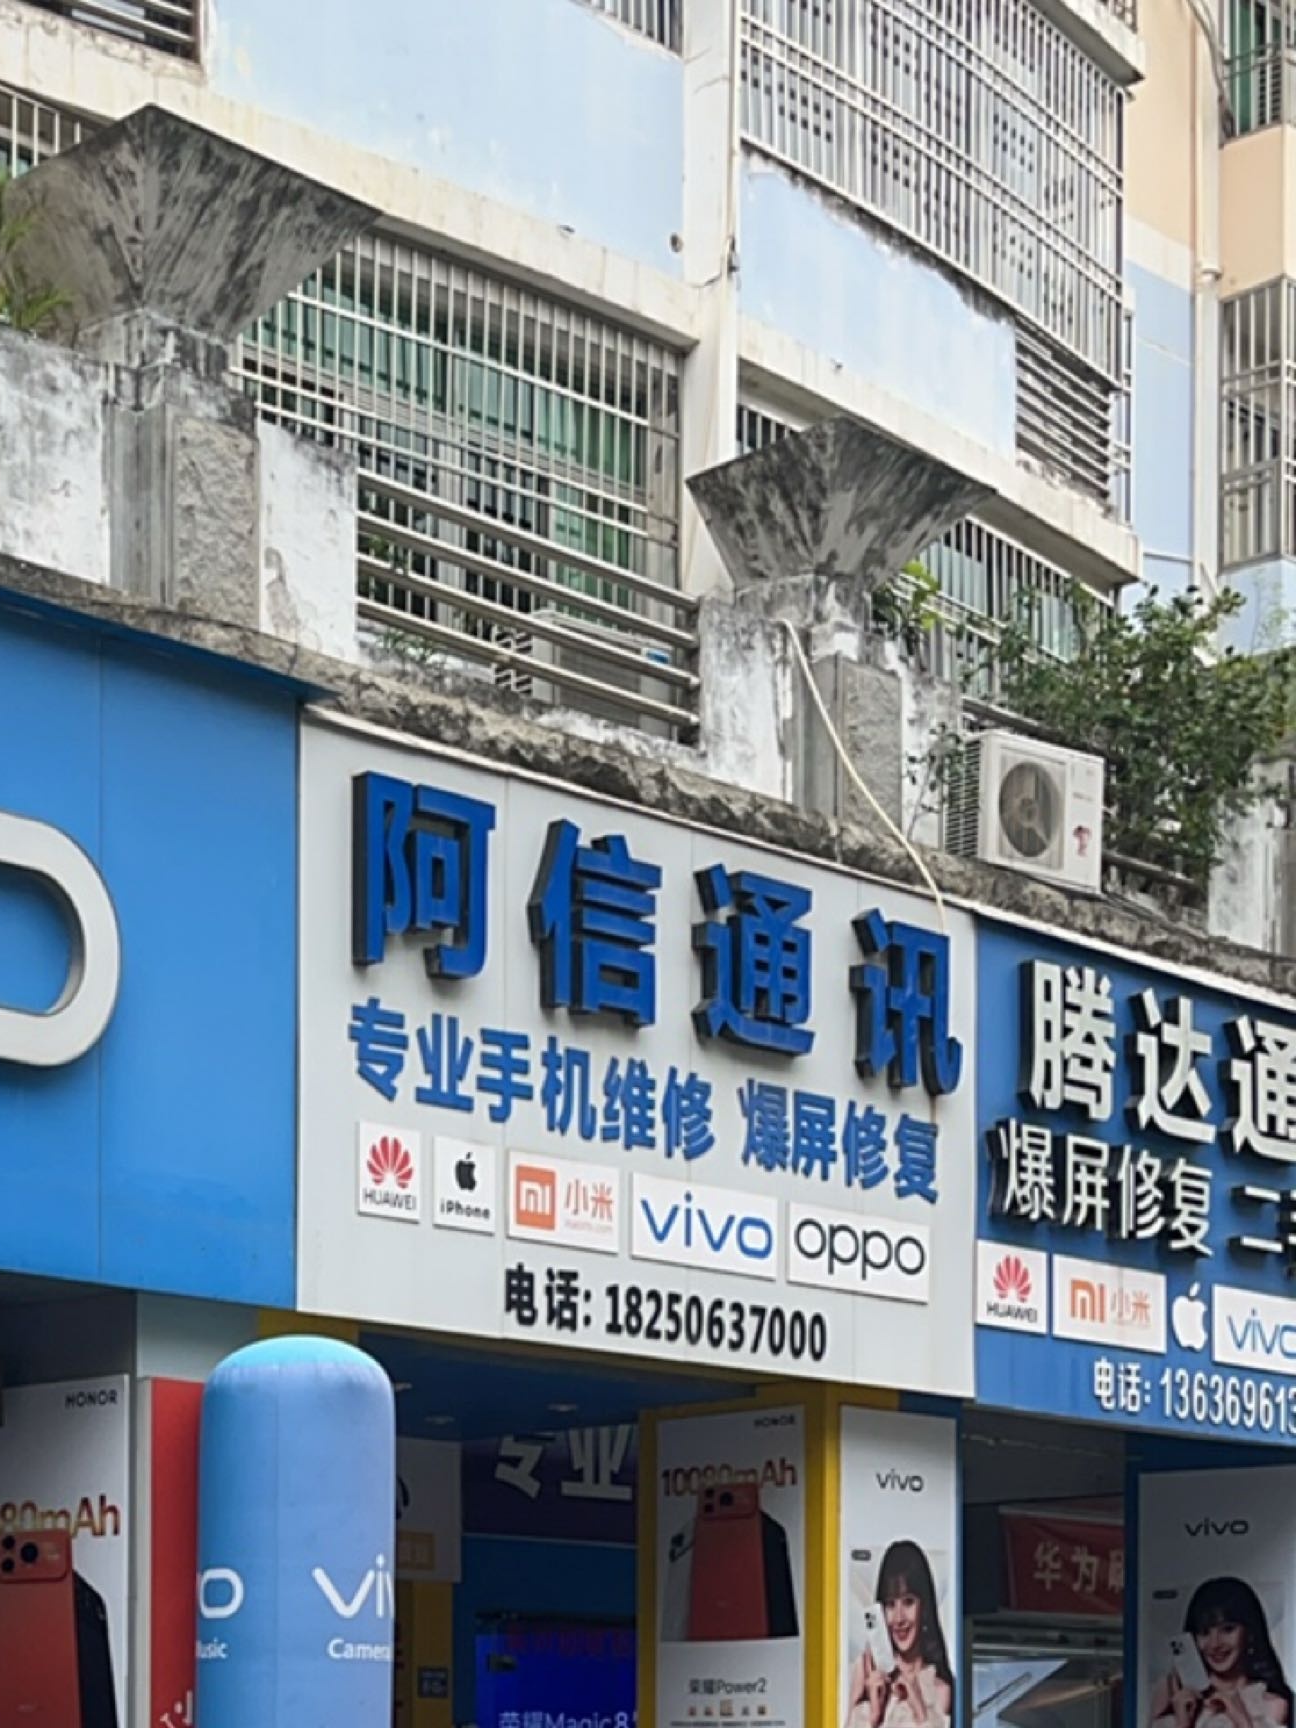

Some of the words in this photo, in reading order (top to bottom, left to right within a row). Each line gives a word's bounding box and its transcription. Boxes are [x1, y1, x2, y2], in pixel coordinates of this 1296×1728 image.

[352, 770, 962, 1096] 阿信通讯
[1018, 959, 1296, 1162] 腾达通
[348, 997, 715, 1160] 专业手机维修
[737, 1078, 938, 1205] 爆屏修复
[363, 1188, 417, 1211] HUAWEI
[440, 1197, 490, 1219] iPhone
[566, 1178, 613, 1221] 小米
[987, 1118, 1212, 1255] 爆屏修复
[1234, 1186, 1296, 1253] 二
[640, 1192, 773, 1260] vivo
[793, 1217, 925, 1280] oppo
[605, 1283, 827, 1362] 18250637000
[986, 1301, 1038, 1324] HUAWEI
[1111, 1288, 1151, 1321] 小米
[64, 1390, 118, 1408] HONOR
[876, 1468, 924, 1493] vivo
[1184, 1518, 1250, 1537] vivo
